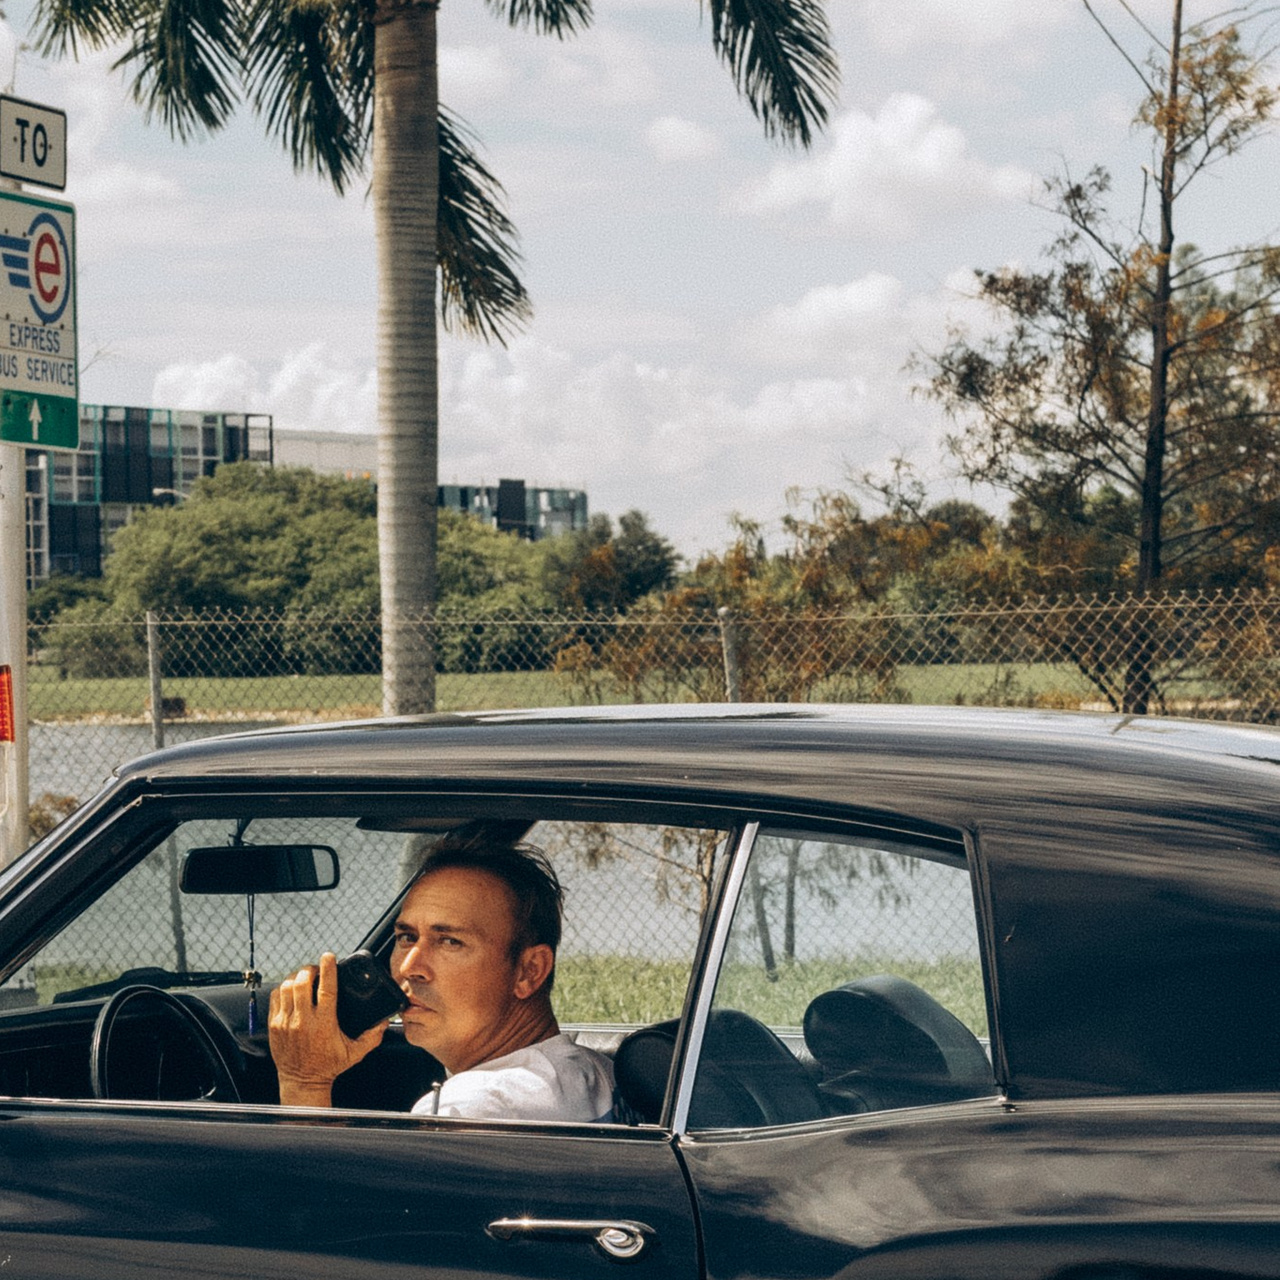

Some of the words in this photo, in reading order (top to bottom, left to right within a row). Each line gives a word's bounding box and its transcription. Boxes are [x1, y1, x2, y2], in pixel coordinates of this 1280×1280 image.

[15, 117, 48, 167] TO
[9, 323, 61, 354] EXPRESS
[26, 357, 75, 386] SERVICE
